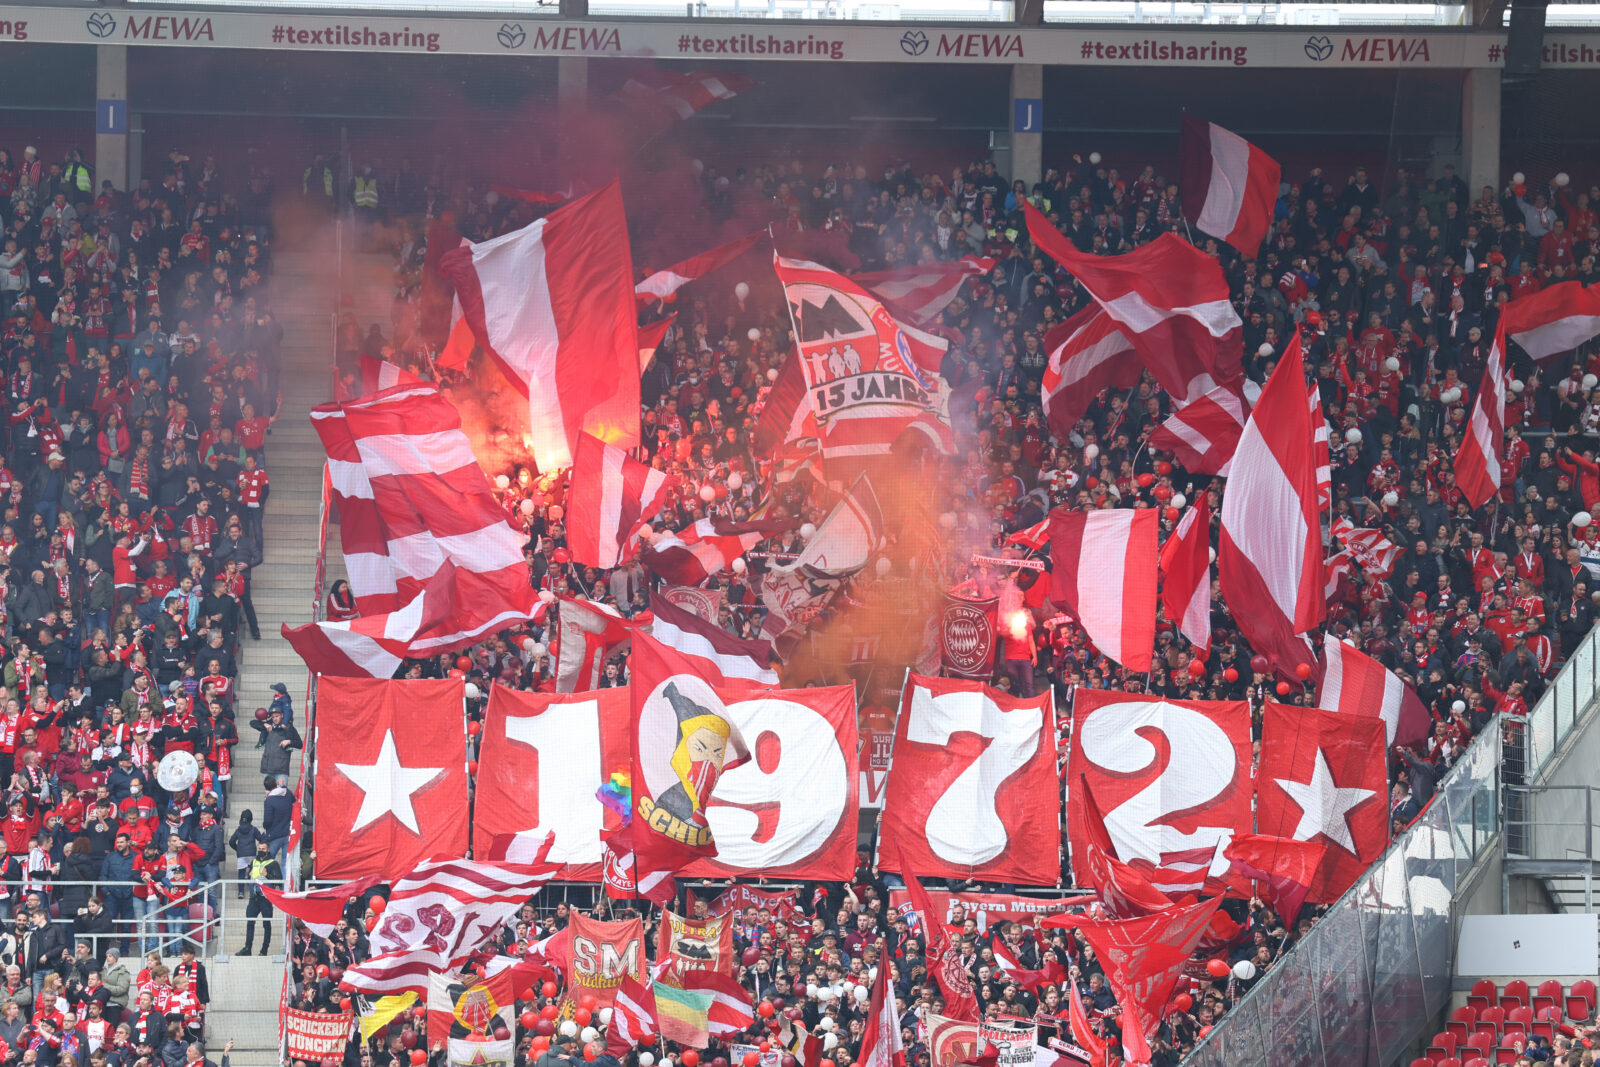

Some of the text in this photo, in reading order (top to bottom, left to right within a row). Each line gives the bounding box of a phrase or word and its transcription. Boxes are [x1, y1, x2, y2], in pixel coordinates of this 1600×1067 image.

[124, 15, 215, 41] MEWA
[272, 26, 441, 52] #textilsharing
[533, 27, 622, 51] MEWA
[678, 35, 844, 60] #textilsharing
[936, 34, 1025, 58] MEWA
[1081, 41, 1248, 66] #textilsharing
[1341, 38, 1431, 62] MEWA
[1024, 104, 1033, 130] J
[816, 382, 846, 411] 15
[906, 685, 1043, 866] 7
[1080, 700, 1236, 877] 2
[949, 899, 1006, 912] Bayern
[1010, 901, 1085, 913] München
[572, 935, 641, 980] SM
